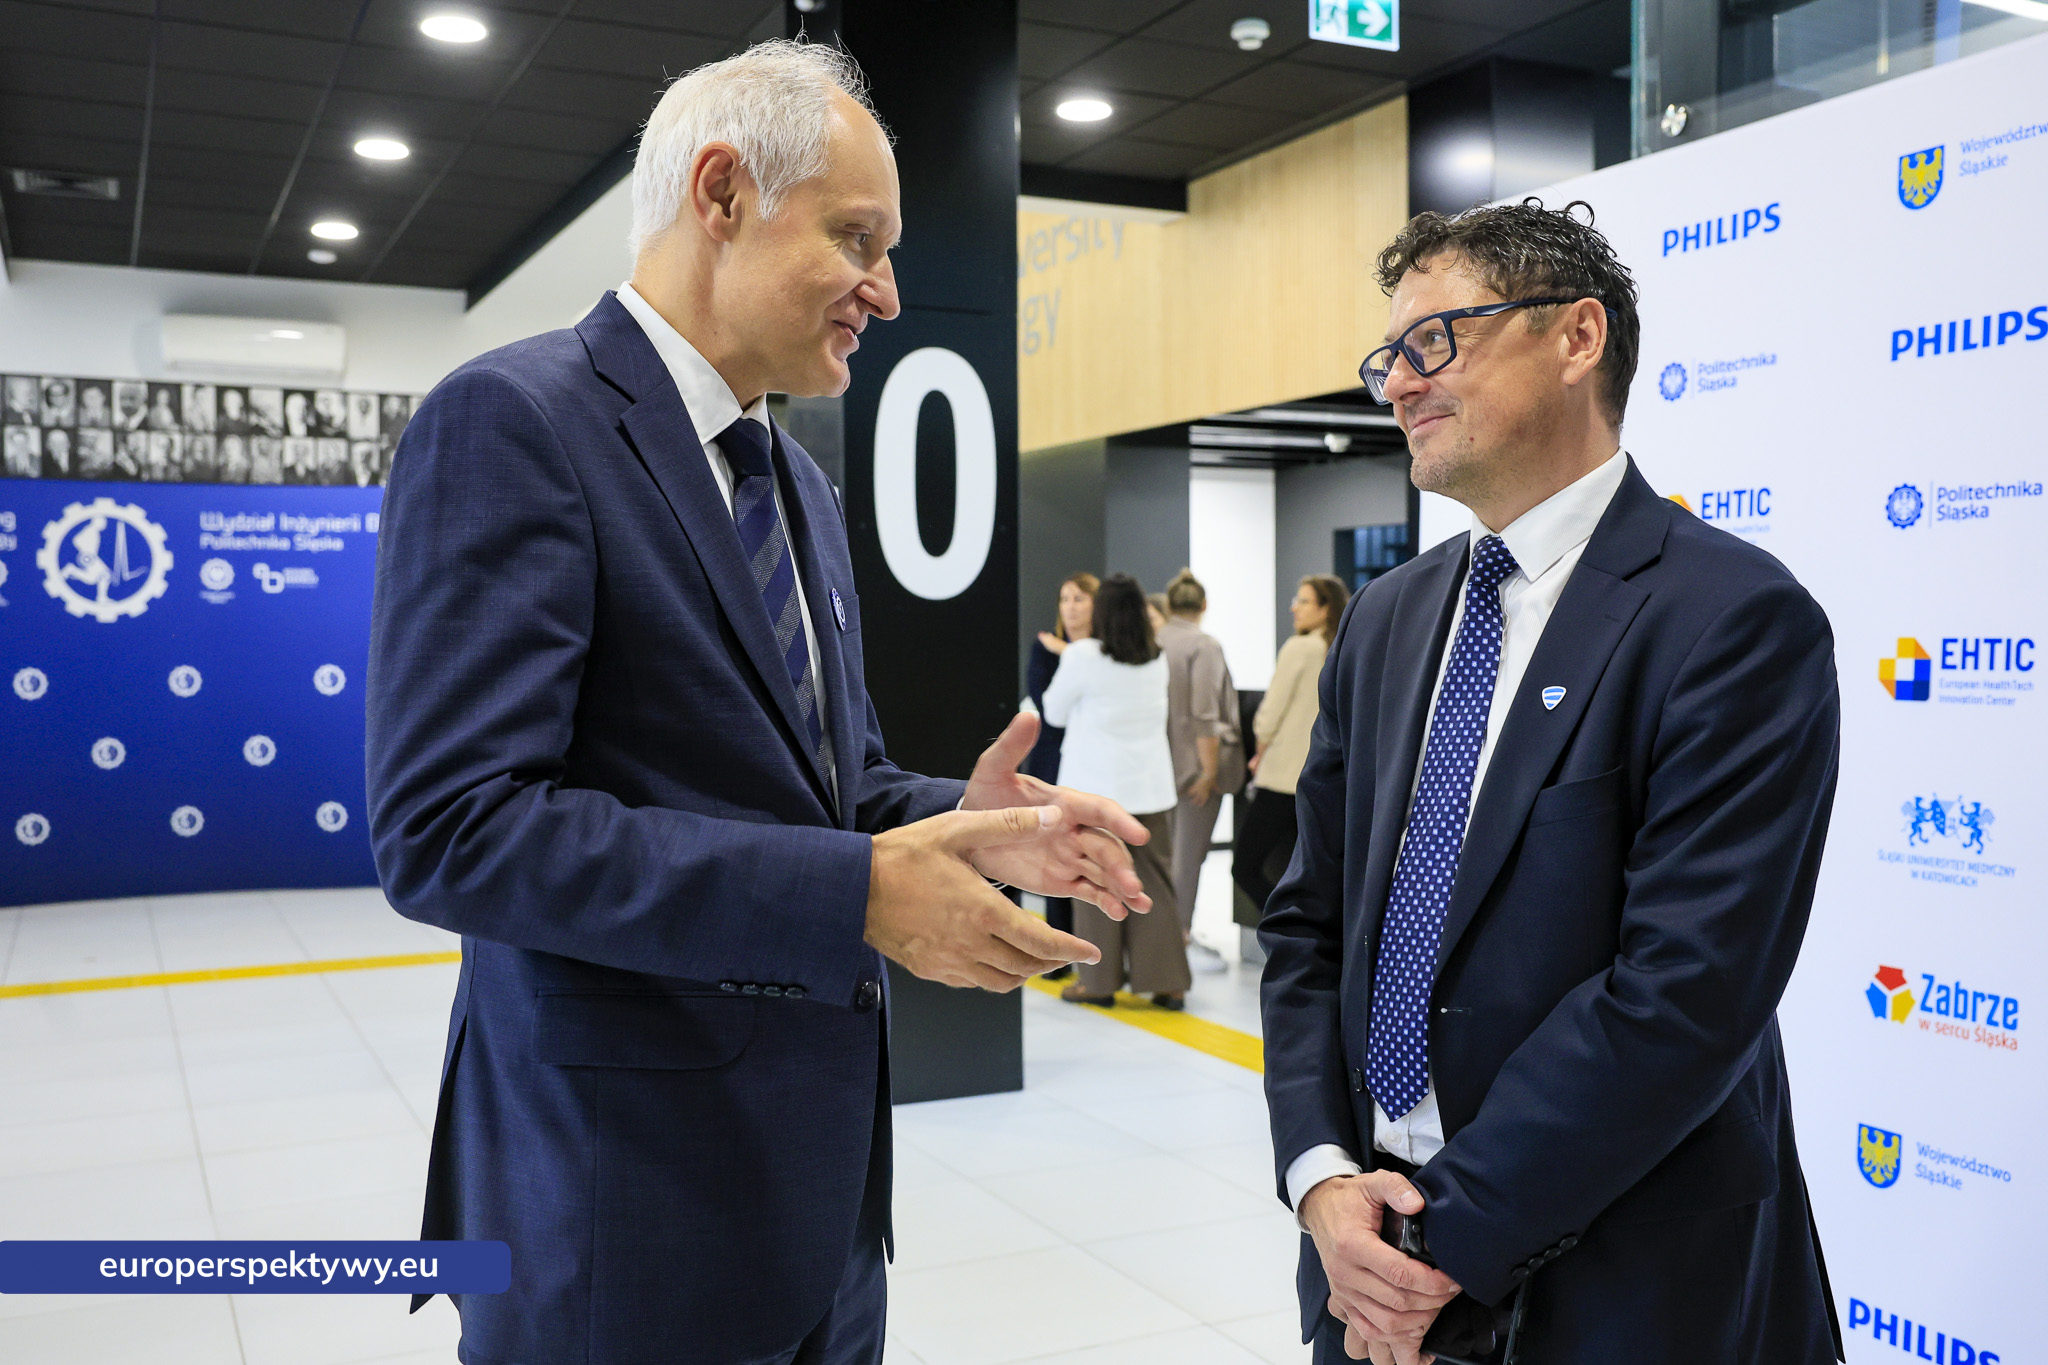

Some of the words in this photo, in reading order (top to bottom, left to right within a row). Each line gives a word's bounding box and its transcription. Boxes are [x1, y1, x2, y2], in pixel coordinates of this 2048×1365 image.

[1663, 202, 1780, 257] PHILIPS
[1891, 305, 2048, 362] PHILIPS
[873, 346, 997, 601] 0
[1937, 481, 2043, 503] Politechnika
[1702, 488, 1771, 520] EHTIC
[1941, 637, 2035, 672] EHTIC
[1920, 973, 2018, 1030] Zabrze
[1935, 1021, 1970, 1041] sercu
